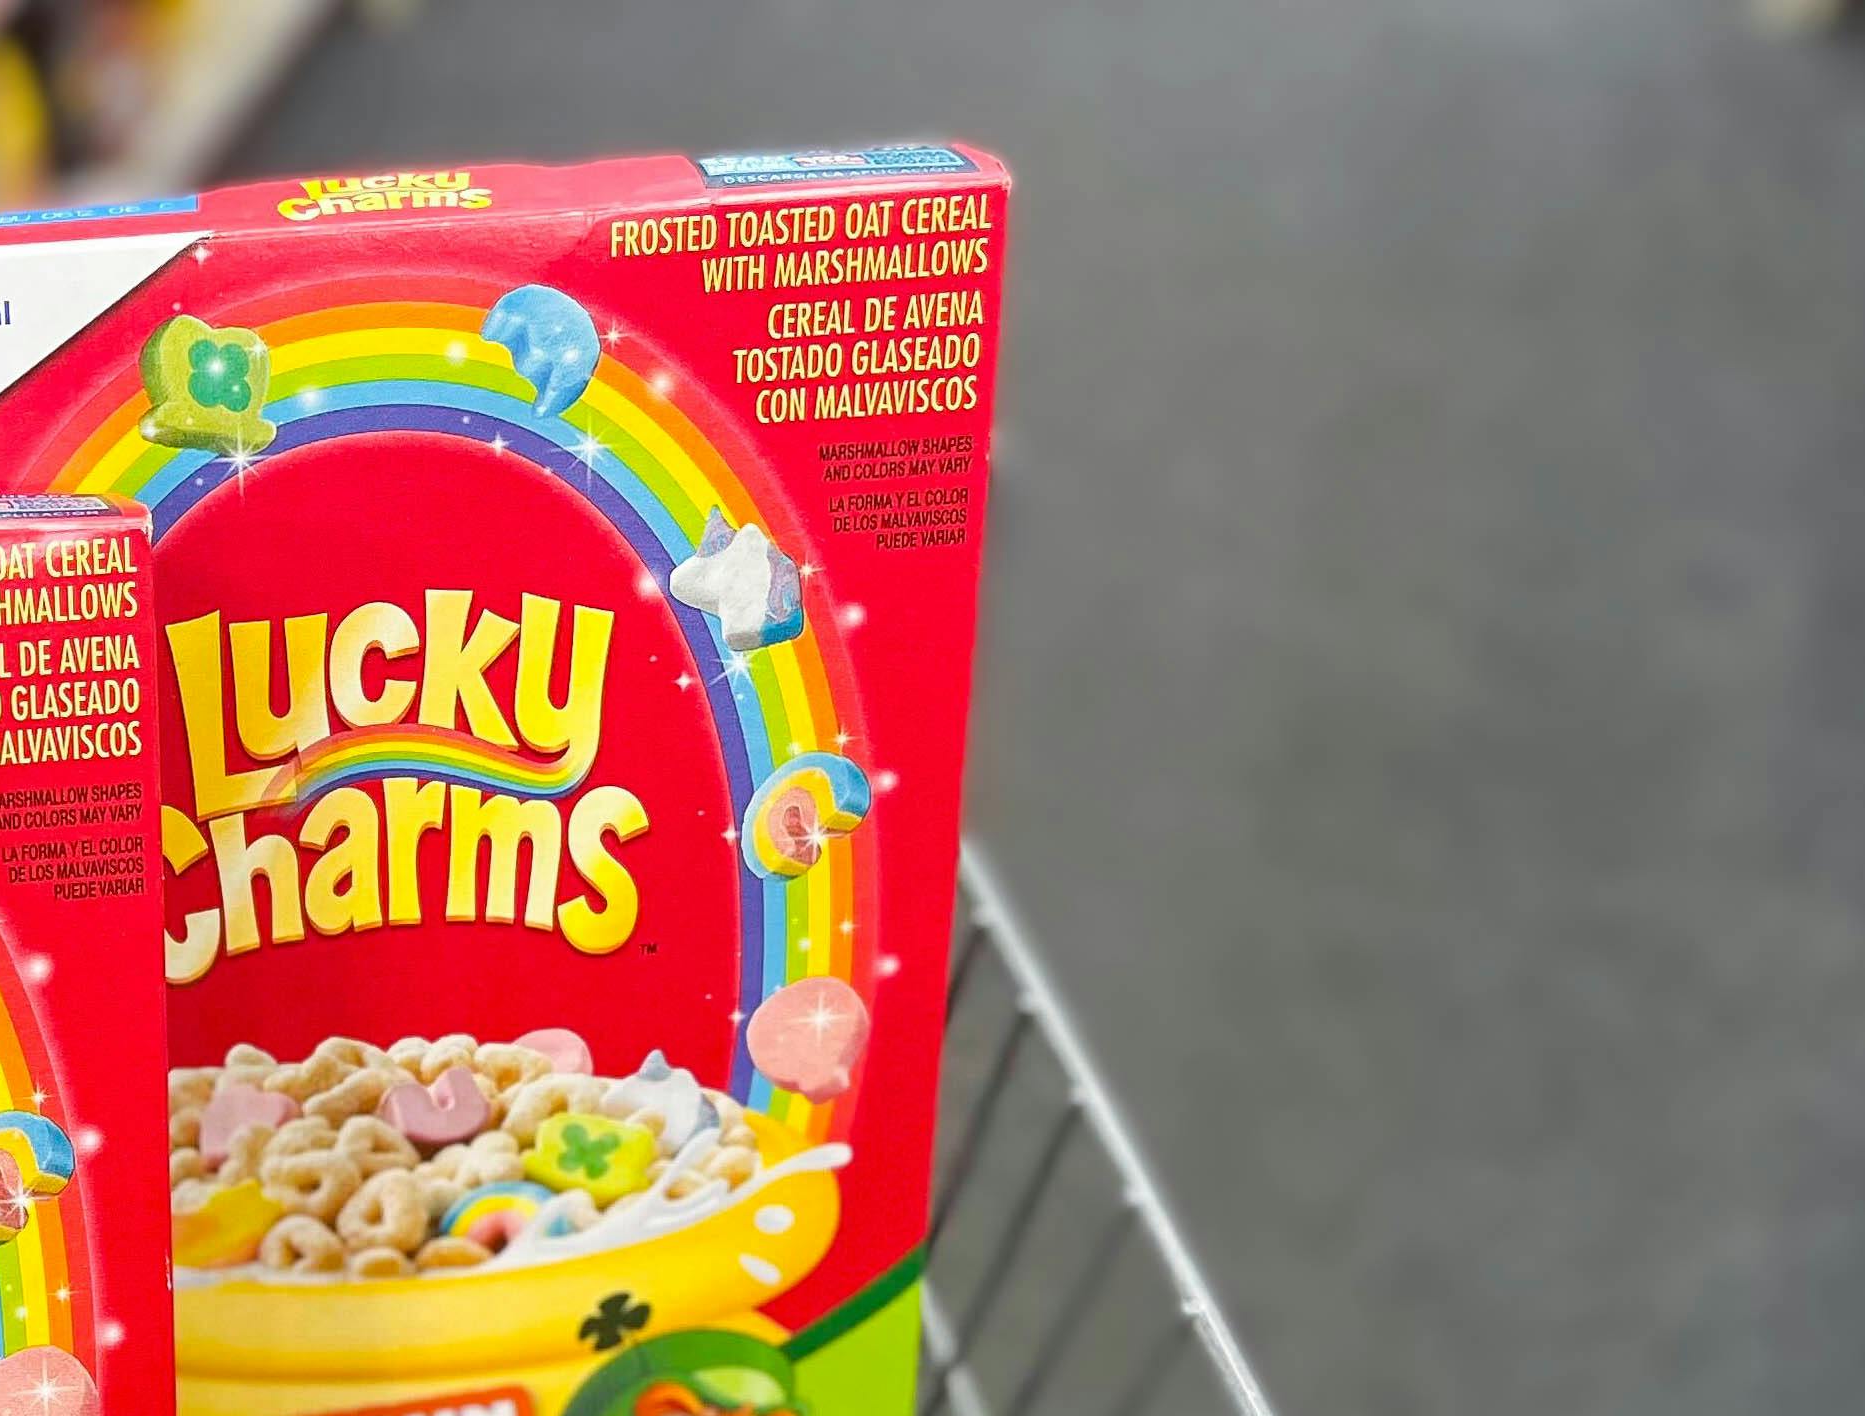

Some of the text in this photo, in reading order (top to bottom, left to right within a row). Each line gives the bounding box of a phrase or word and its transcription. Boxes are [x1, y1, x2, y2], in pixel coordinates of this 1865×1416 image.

[299, 172, 471, 200] Lucky
[277, 188, 493, 222] Charms
[610, 193, 992, 258] FROSTED TOASTED OAT CEREAL
[701, 237, 989, 293] WITH MARSHMALLOWS
[767, 289, 984, 340] CEREAL DE AVENA
[733, 332, 981, 384] TOSTADO GLASEADO
[755, 375, 977, 424] CON MALVAVISCOS
[819, 435, 973, 462] MARSHMALLOW SHAPES
[824, 456, 971, 482] AND COLORS MAY VARY
[829, 487, 969, 513] LA FORMA Y EL COLOR
[834, 508, 968, 533] DE LOS MALVAVISCOS
[876, 528, 966, 550] PUEDE VARIAR
[45, 536, 137, 579] CEREAL
[20, 638, 52, 677] DE
[59, 634, 141, 674] AVENA
[10, 677, 141, 721] GLASEADO
[165, 589, 616, 822] Lucky
[91, 782, 143, 801] SHAPES
[24, 808, 77, 829] COLORS
[79, 806, 107, 825] MAY
[108, 803, 143, 823] VARY
[2, 836, 143, 863] LA FORMA Y EL COLOR
[9, 857, 144, 884] DE LOS MALVAVISCOS
[54, 878, 144, 901] PUEDE VARIAR
